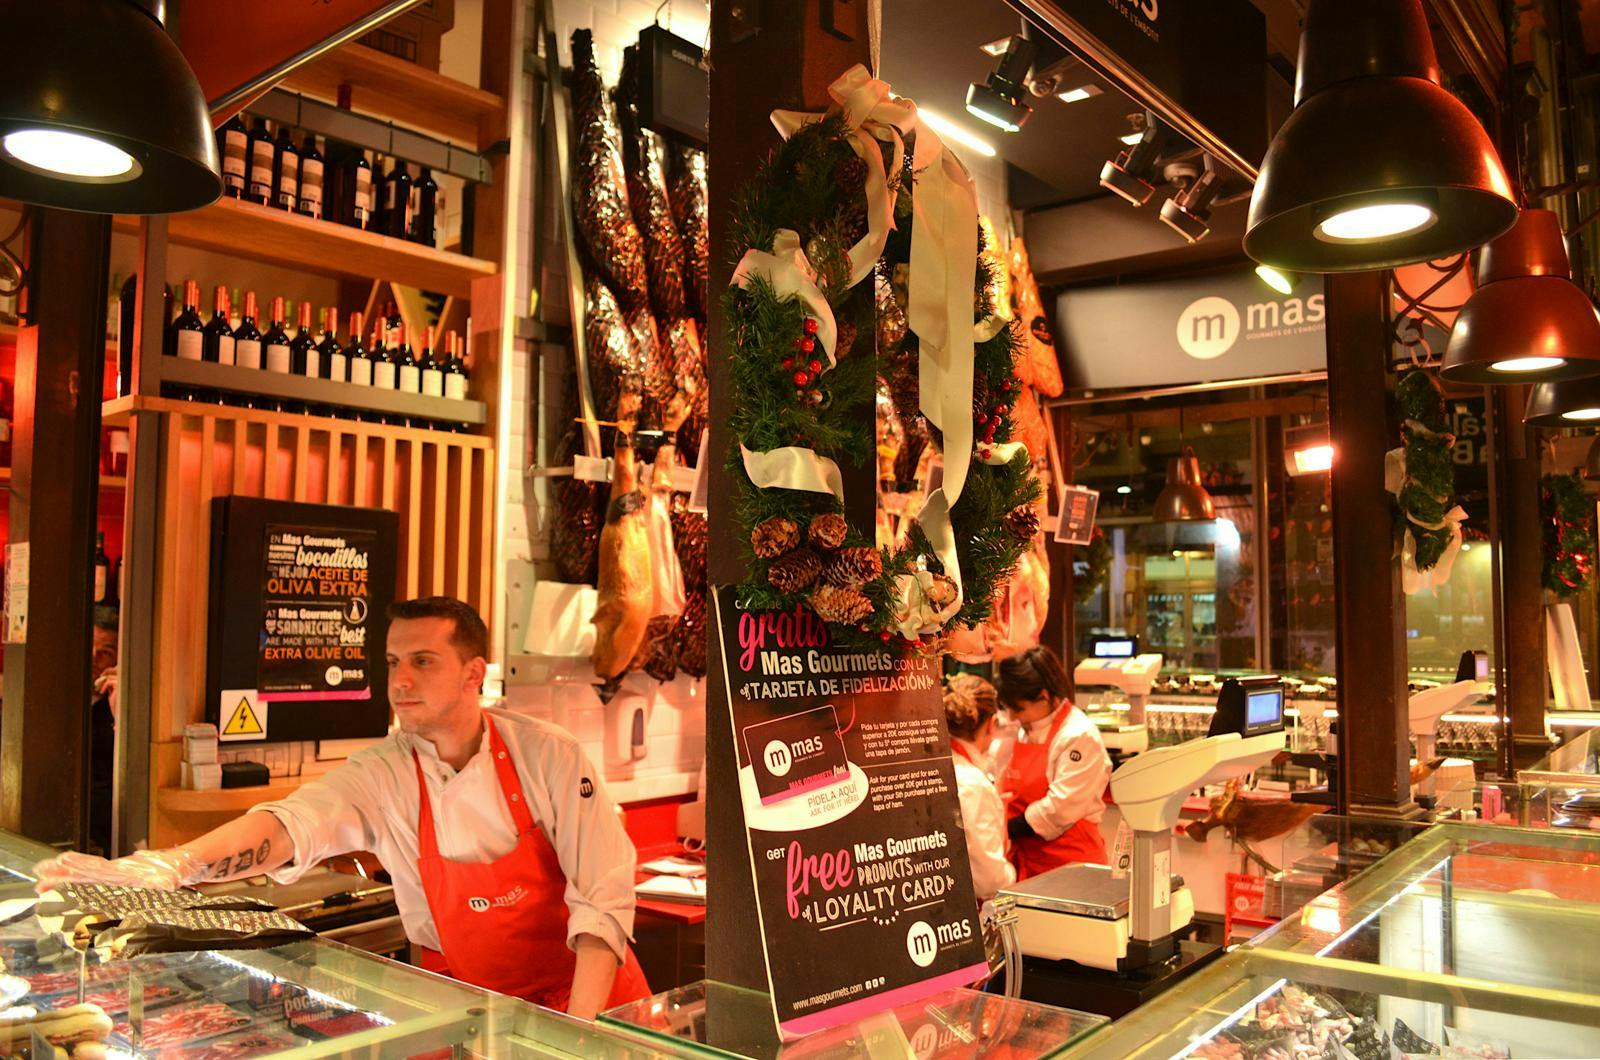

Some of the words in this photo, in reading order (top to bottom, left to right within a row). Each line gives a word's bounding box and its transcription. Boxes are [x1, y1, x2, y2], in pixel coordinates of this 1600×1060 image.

[1246, 294, 1326, 330] mas
[282, 533, 302, 545] Mas
[303, 534, 346, 548] Gourmets
[296, 546, 368, 569] bocadillos
[309, 567, 350, 580] ACEITE
[353, 569, 368, 581] DE
[267, 578, 314, 594] OLIVA
[319, 581, 368, 596] EXTRA
[278, 608, 298, 619] Mas
[300, 608, 342, 620] Gourmets
[340, 625, 366, 644] best
[264, 648, 302, 660] EXTRA
[305, 647, 341, 660] OLIVE
[344, 648, 365, 660] OIL
[760, 650, 803, 676] Mas
[807, 650, 893, 674] Gourmets
[894, 659, 914, 672] CON
[916, 658, 929, 670] LA
[343, 669, 364, 679] mas
[750, 682, 817, 700] TARJETA
[820, 679, 839, 695] DE
[842, 673, 928, 694] FIDELIZACIÓN
[861, 723, 873, 731] Pide
[879, 722, 895, 730] tarjeta
[921, 719, 938, 727] compra
[862, 732, 883, 740] superior
[898, 728, 919, 737] consigue
[891, 738, 909, 746] compra
[926, 735, 939, 743] gratis
[791, 735, 824, 758] mas
[865, 750, 875, 758] una
[875, 749, 887, 758] tapa
[869, 776, 879, 784] Ask
[879, 775, 887, 783] for
[887, 774, 899, 783] your
[899, 772, 910, 780] card
[911, 771, 920, 779] and
[870, 784, 893, 794] purchase
[915, 780, 923, 788] get
[872, 794, 883, 802] with
[884, 793, 895, 802] your
[895, 791, 904, 799] 5th
[904, 789, 926, 798] purchase
[926, 788, 934, 796] get
[807, 791, 836, 808] PÍDELA
[786, 840, 854, 920] free
[854, 842, 884, 863] Mas
[886, 830, 948, 857] Gourmets
[857, 857, 914, 886] PRODUCTS
[914, 861, 934, 875] WITH
[935, 857, 951, 870] OUR
[814, 885, 896, 924] LOYALTY
[901, 874, 945, 903] CARD
[937, 918, 972, 945] mas
[792, 982, 863, 1010] www.masgourmets.com
